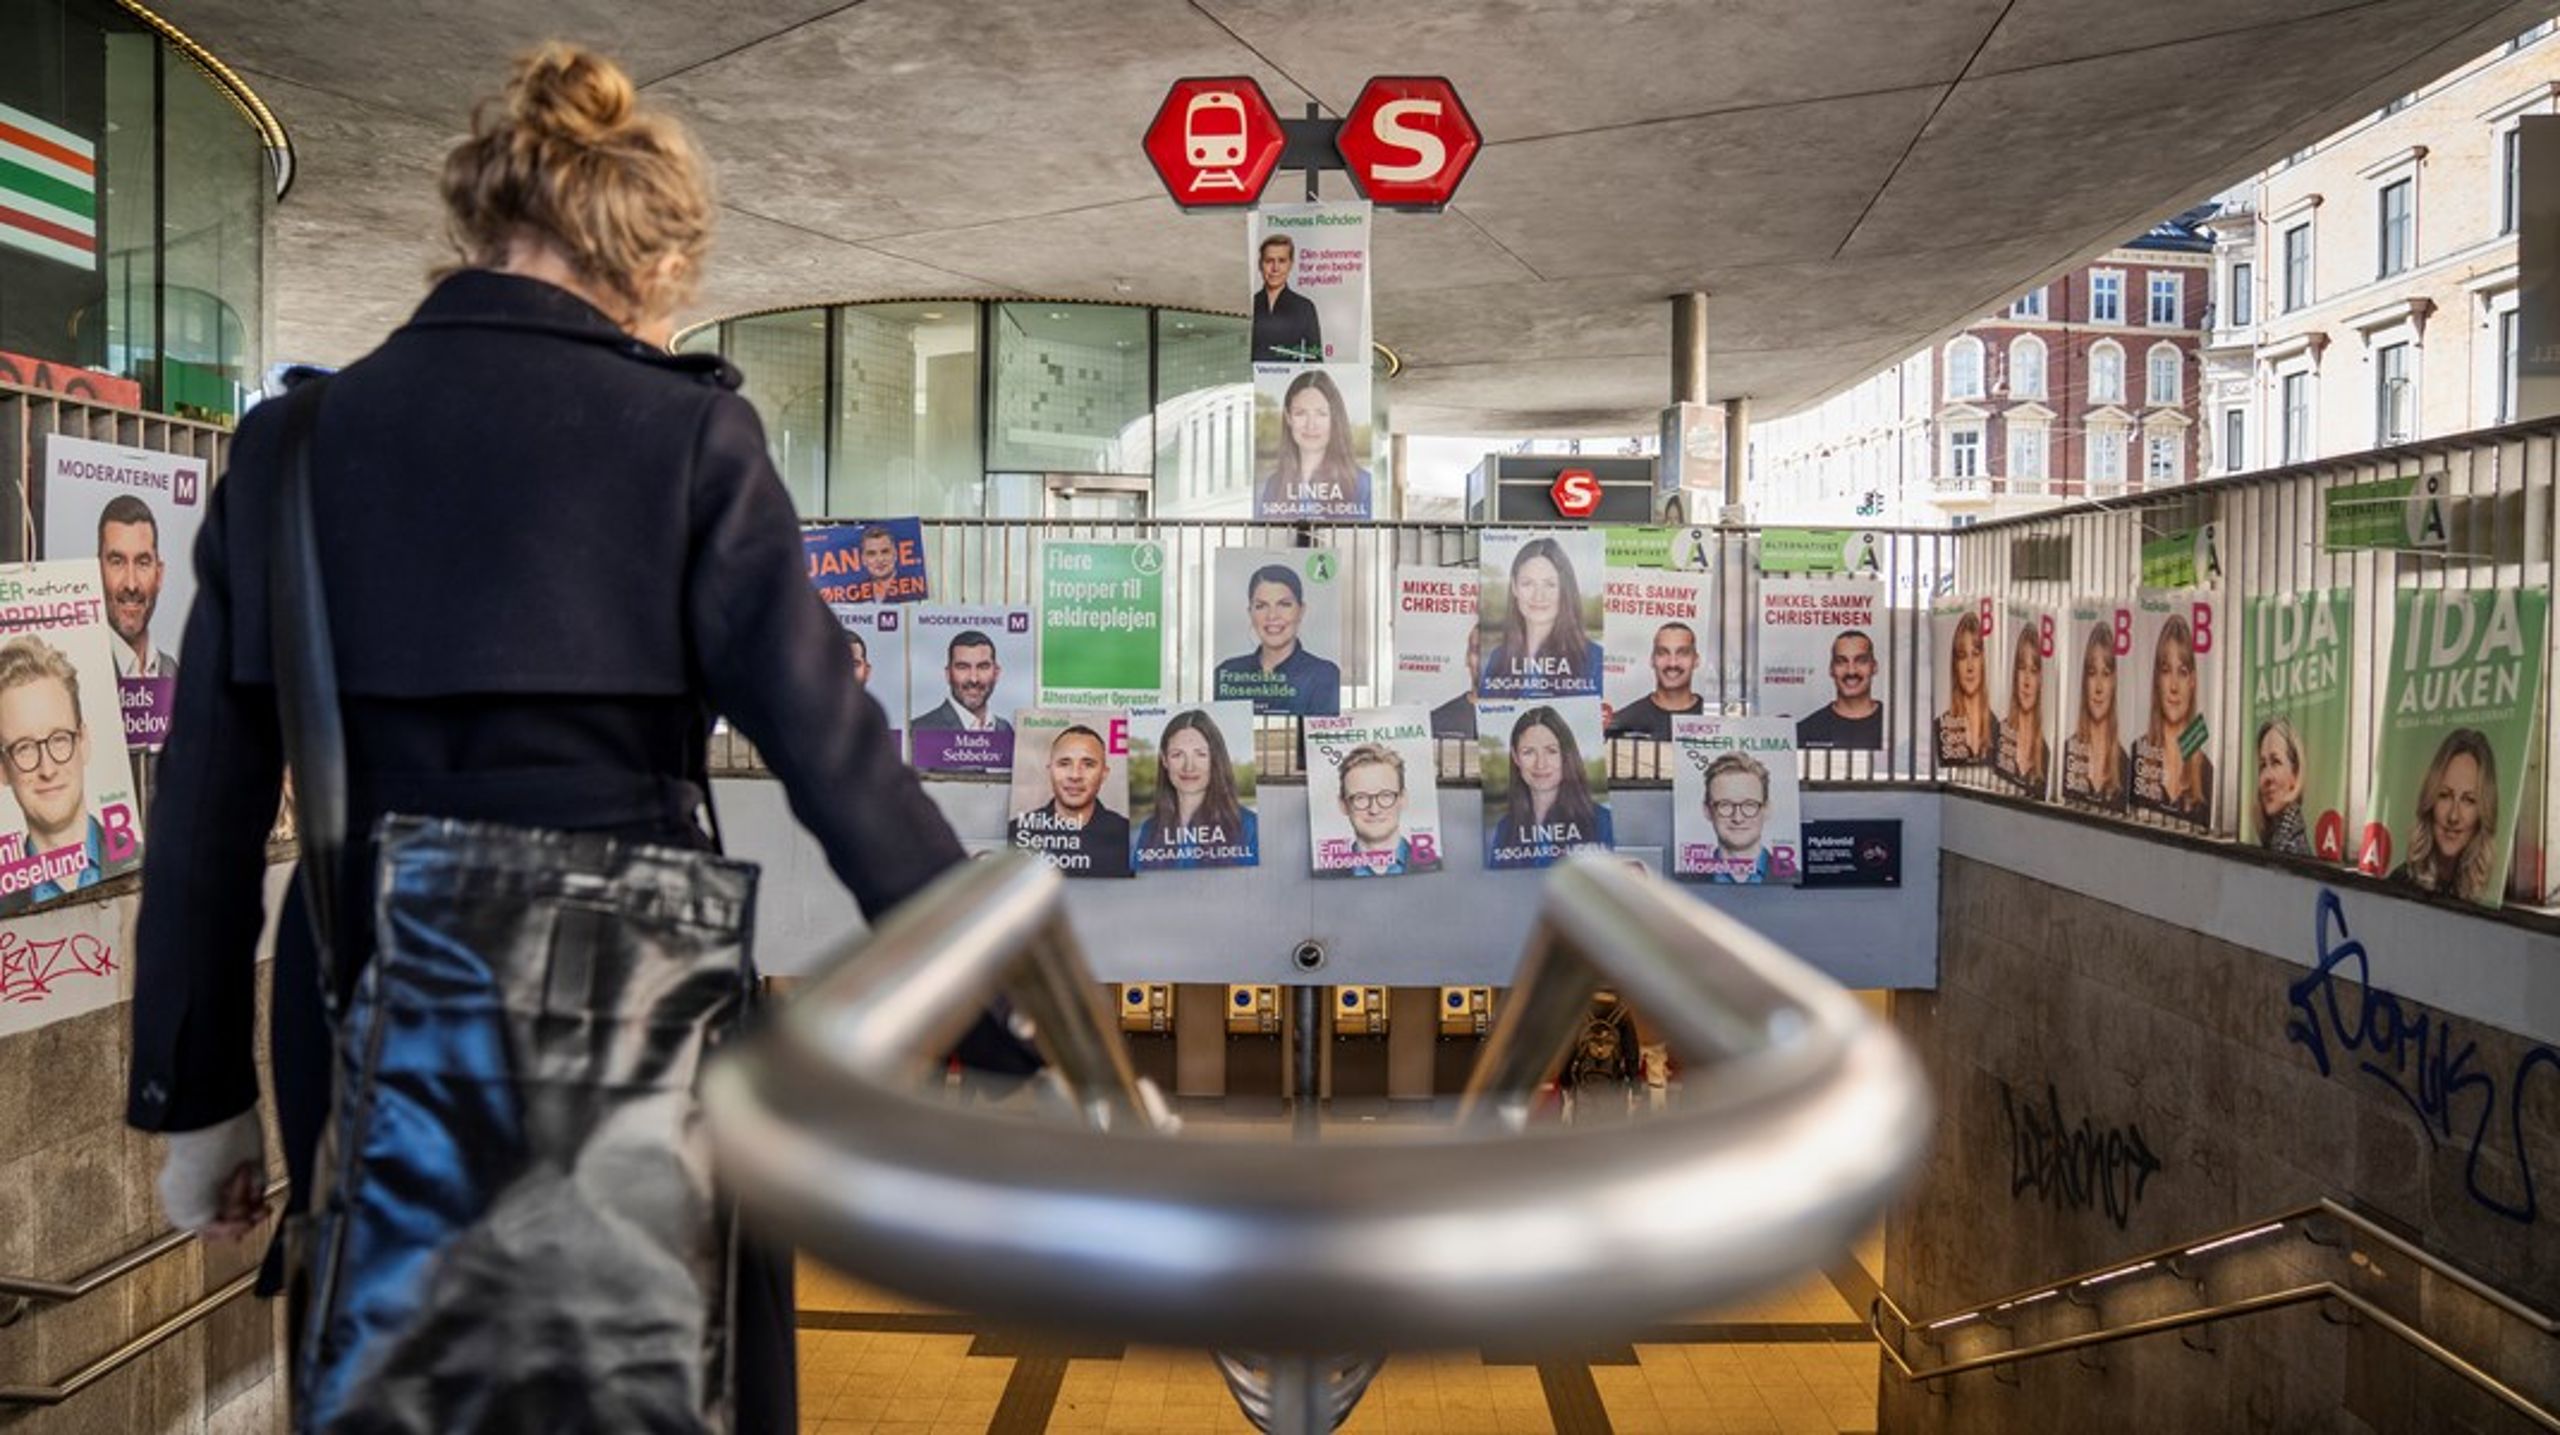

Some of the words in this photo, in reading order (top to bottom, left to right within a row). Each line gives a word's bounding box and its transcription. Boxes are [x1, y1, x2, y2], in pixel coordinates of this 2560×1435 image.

[1370, 99, 1446, 182] S
[1267, 215, 1313, 227] Thomas
[1316, 213, 1362, 226] Rohden
[1300, 249, 1316, 259] Din
[1319, 249, 1362, 259] stemme
[1299, 262, 1312, 271] for
[1316, 263, 1330, 271] en
[1332, 261, 1362, 271] bedre
[1298, 273, 1342, 286] psykiatri
[58, 458, 169, 491] MODERATERNE
[177, 476, 194, 499] M
[1286, 482, 1344, 500] LINEA
[1562, 476, 1591, 508] S
[1262, 502, 1367, 515] SØGAARD-LIDELL
[1049, 552, 1093, 571] Flere
[1605, 547, 1668, 556] TERNATIVET
[809, 547, 861, 578] JAN
[819, 576, 926, 603] ØRGENSEN
[1049, 578, 1117, 602] tropper
[1121, 577, 1142, 599] til
[1403, 580, 1455, 596] MIKKEL
[1606, 583, 1642, 598] KKEL
[1646, 585, 1697, 601] SAMMY
[1401, 596, 1480, 615] CHRISTEN
[1603, 597, 1698, 618] RISTENSEN
[1765, 594, 1818, 608] MIKKEL
[1820, 595, 1873, 608] SAMMY
[0, 599, 101, 634] BRUGET
[839, 614, 874, 625] TERNE
[880, 613, 896, 628] M
[918, 615, 1004, 627] MODERATERNE
[1010, 616, 1026, 630] M
[1047, 607, 1157, 632] ældreplejen
[1765, 609, 1873, 626] CHRISTENSEN
[1981, 597, 1993, 637] B
[2040, 614, 2054, 658] B
[2113, 608, 2132, 656] B
[2192, 602, 2212, 654] B
[2257, 589, 2339, 667] IDA
[2404, 588, 2525, 671] IDA
[1218, 669, 1287, 683] Franciska
[1511, 657, 1572, 675] LINEA
[2256, 649, 2339, 703] AUKEN
[1218, 684, 1297, 698] Rosenkilde
[1485, 677, 1597, 691] SØGAARD-LIDELL
[2396, 661, 2521, 715] AUKEN
[125, 711, 169, 734] belov
[1131, 707, 1168, 717] Venstre
[954, 734, 991, 748] Mads
[1372, 724, 1426, 741] KLIMA
[942, 748, 1002, 762] Sebbelov
[1739, 737, 1793, 752] KLIMA
[1017, 811, 1083, 831] Mikkel
[101, 802, 135, 863] B
[1015, 829, 1081, 850] Senna
[1163, 825, 1226, 846] LINEA
[1519, 822, 1582, 844] LINEA
[2322, 825, 2338, 852] A
[1038, 849, 1092, 870] loom
[1135, 847, 1255, 863] SØGAARD-LIDELL
[1410, 833, 1437, 865] B
[2364, 843, 2380, 866] A
[0, 843, 90, 895] oselund
[1771, 845, 1797, 877] B
